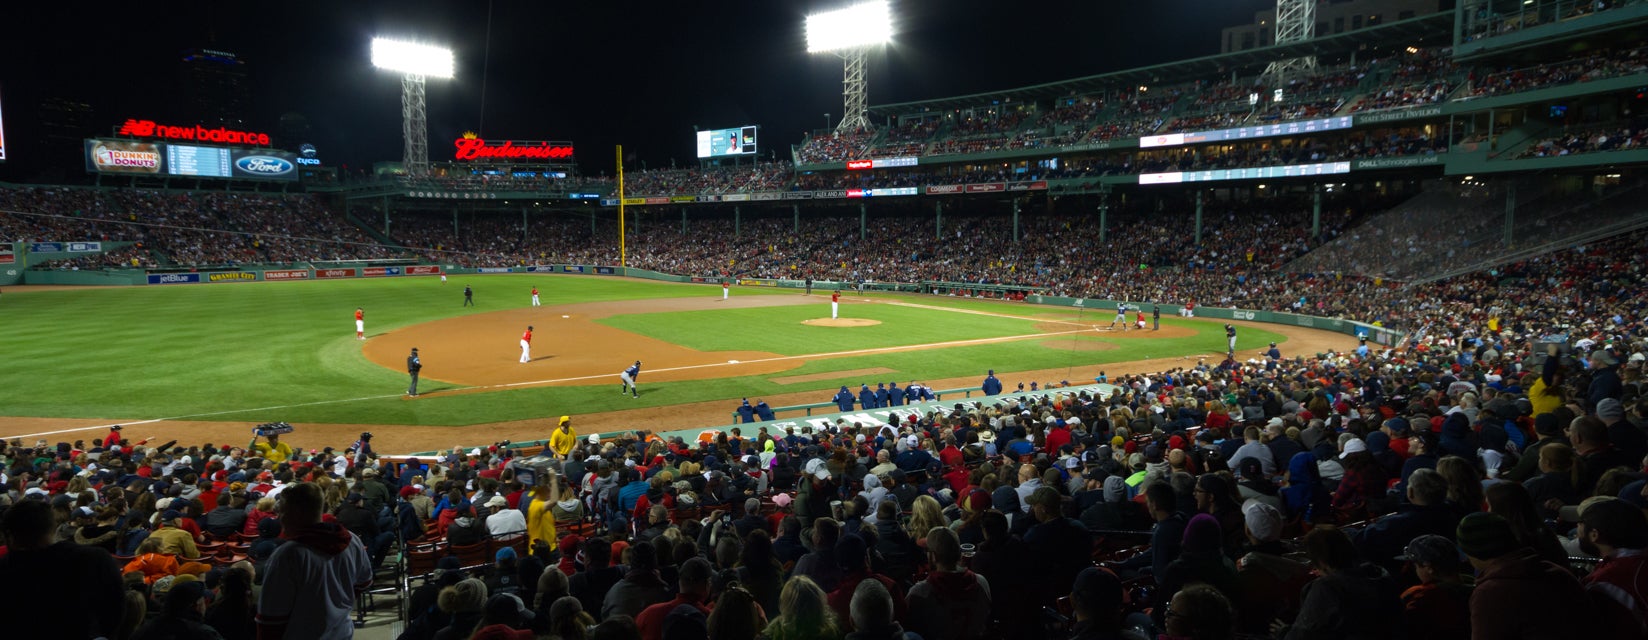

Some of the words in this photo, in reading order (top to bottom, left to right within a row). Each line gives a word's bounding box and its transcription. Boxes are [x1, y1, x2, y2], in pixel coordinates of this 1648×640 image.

[1360, 114, 1379, 123] STATE
[1380, 112, 1404, 121] STREET
[1406, 107, 1441, 118] PAVILION
[454, 137, 574, 160] Budweiser
[114, 151, 157, 160] DUNKIN'
[114, 158, 155, 167] DONUTS
[247, 158, 282, 172] Ford
[297, 157, 320, 165] tyco
[1358, 160, 1377, 168] DELL
[1419, 156, 1438, 164] Level
[210, 273, 239, 282] GRANITE
[240, 272, 256, 281] CITY
[265, 271, 289, 279] TRADER
[291, 270, 308, 278] JOE'S
[325, 270, 347, 278] xfinity
[160, 275, 188, 284] jetBlue
